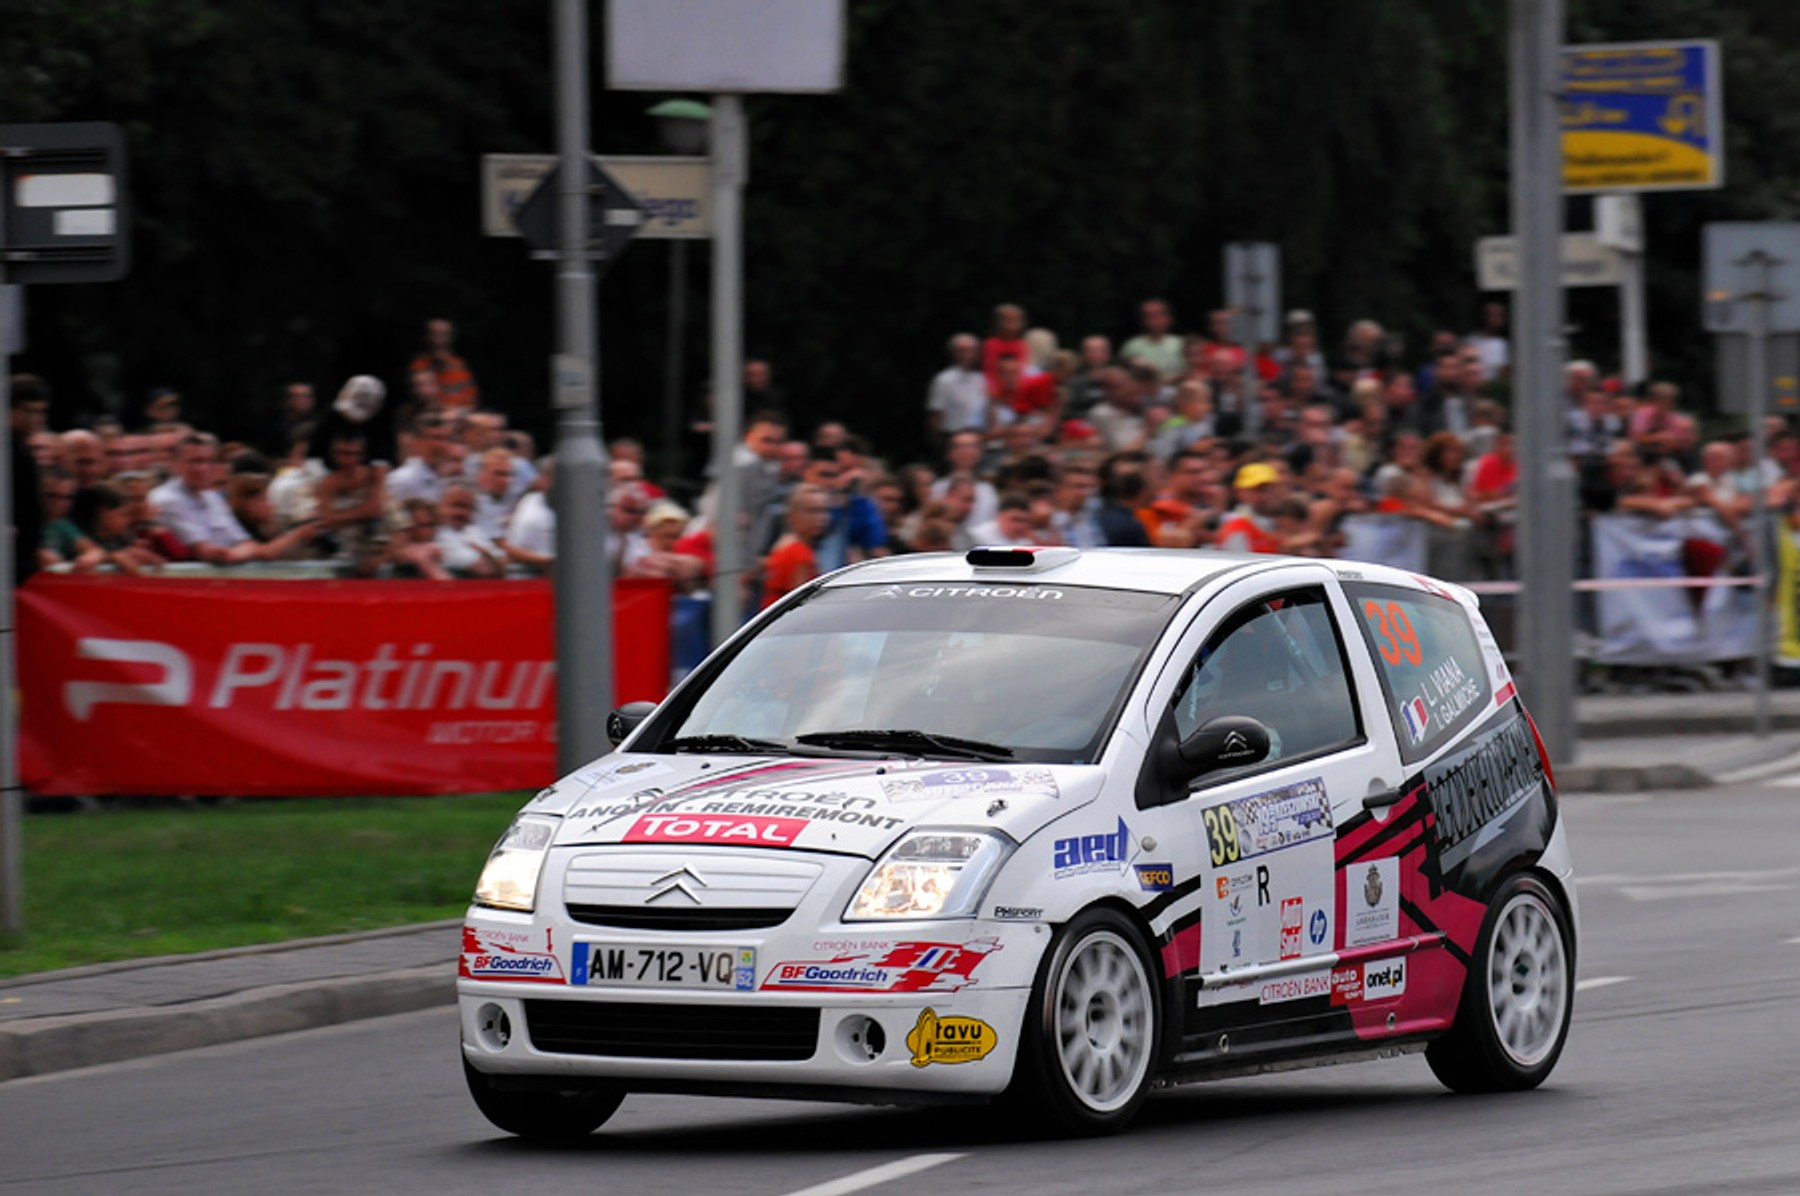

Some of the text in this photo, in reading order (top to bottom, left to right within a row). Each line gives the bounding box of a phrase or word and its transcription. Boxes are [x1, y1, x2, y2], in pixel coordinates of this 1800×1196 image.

[1364, 600, 1423, 667] 39
[941, 770, 989, 784] 39
[700, 801, 905, 830] REMIREMONT
[643, 815, 792, 842] TOTAL
[1203, 805, 1240, 866] 39
[1053, 815, 1129, 870] aed
[1256, 865, 1271, 906] R
[473, 955, 554, 972] BFGoodrich
[588, 947, 734, 985] AM-712-VQ
[780, 966, 888, 983] BFGoodrich
[737, 970, 754, 987] 52
[1303, 974, 1330, 996] BANK
[1331, 968, 1358, 985] auto
[935, 1020, 982, 1040] tavu
